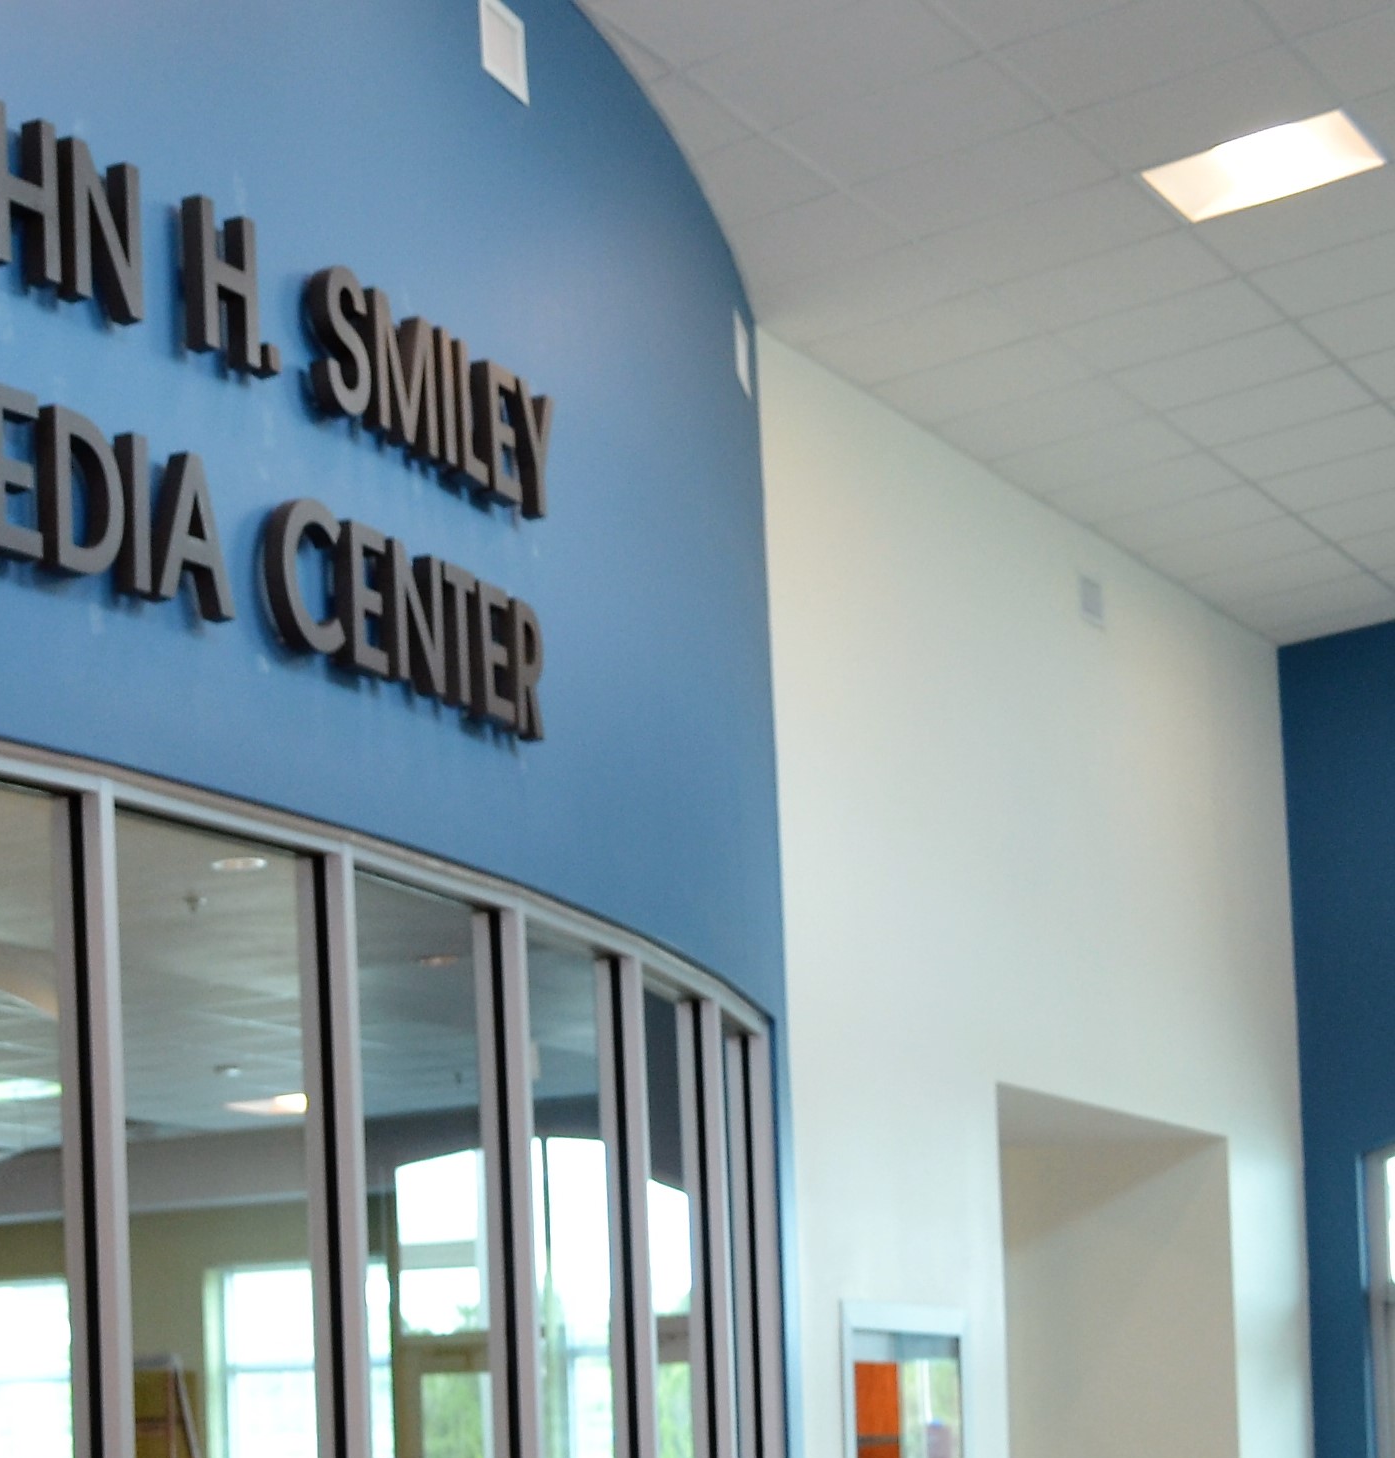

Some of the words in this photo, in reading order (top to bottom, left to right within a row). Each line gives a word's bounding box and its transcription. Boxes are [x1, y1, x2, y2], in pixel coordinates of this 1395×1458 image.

[181, 194, 281, 379] H.
[306, 265, 554, 520] SMILEY
[265, 498, 545, 741] CENTER
